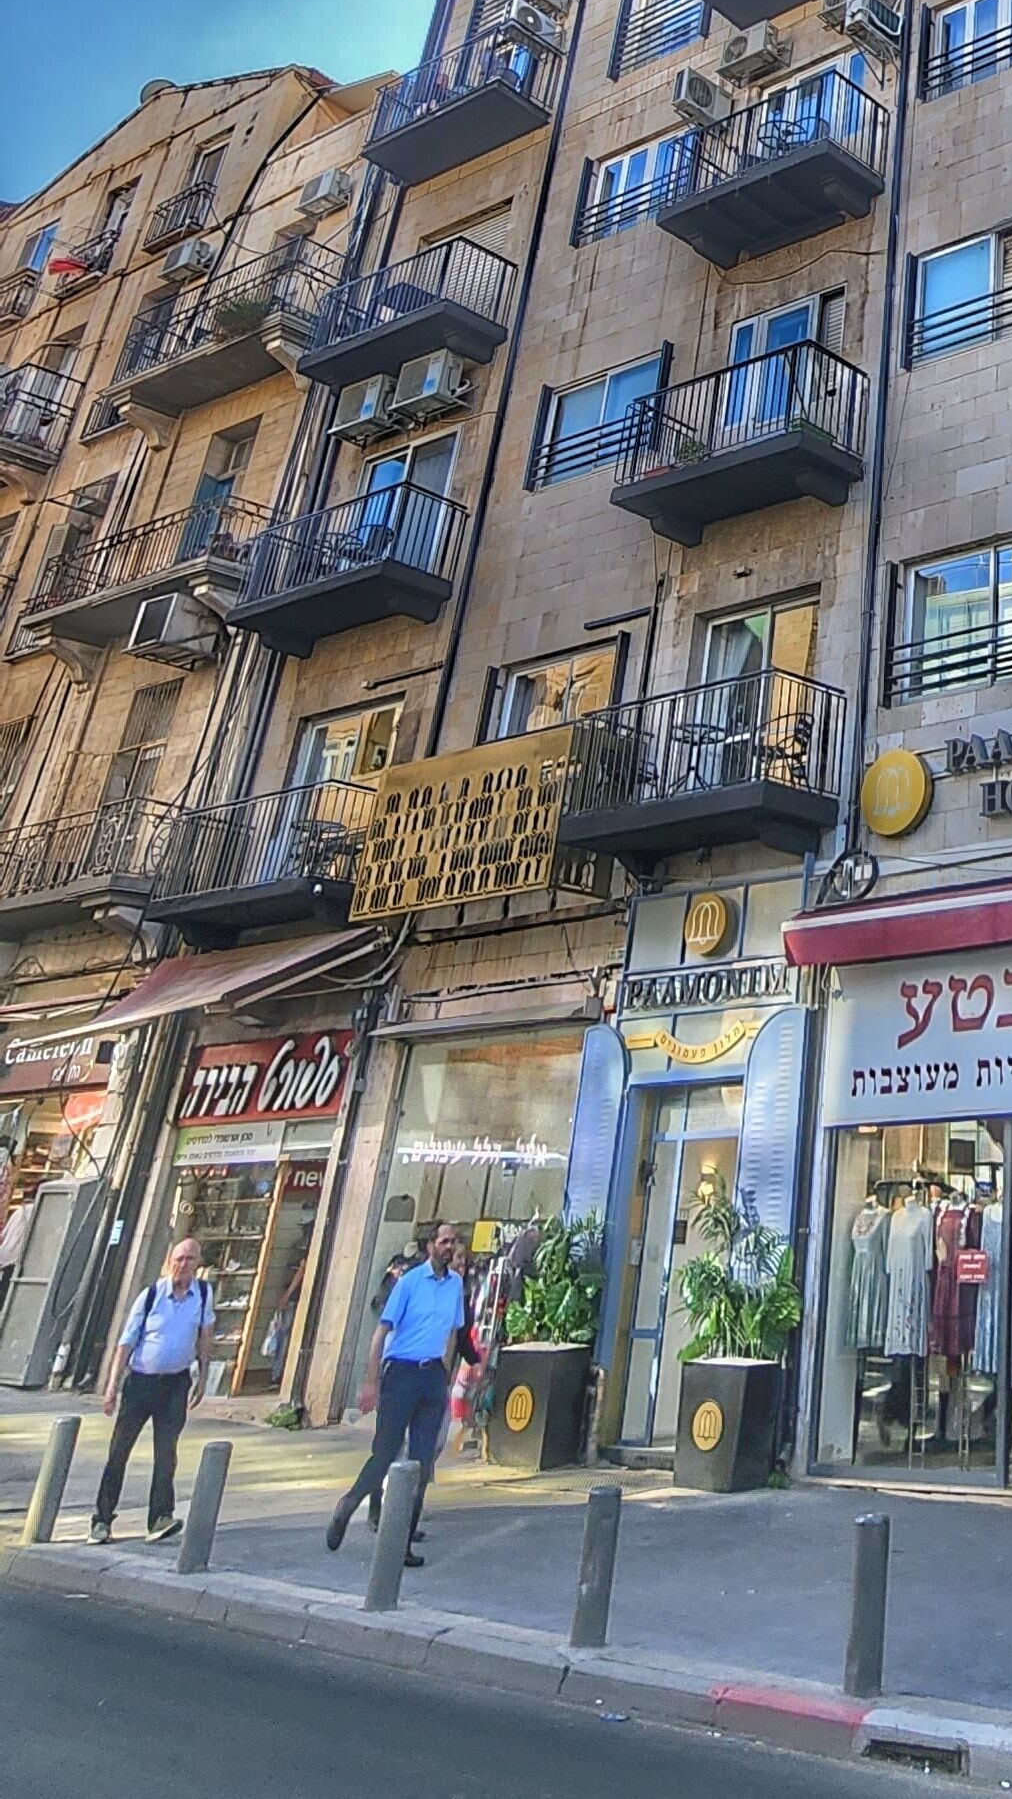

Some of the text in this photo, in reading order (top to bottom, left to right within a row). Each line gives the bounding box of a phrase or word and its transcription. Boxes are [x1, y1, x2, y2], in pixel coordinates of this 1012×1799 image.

[624, 963, 791, 1010] PAAMONIM
[659, 1033, 707, 1059] פעמונים
[178, 1064, 259, 1120] הבירה
[851, 1061, 960, 1098] מעוצבות
[293, 1170, 323, 1188] ne
